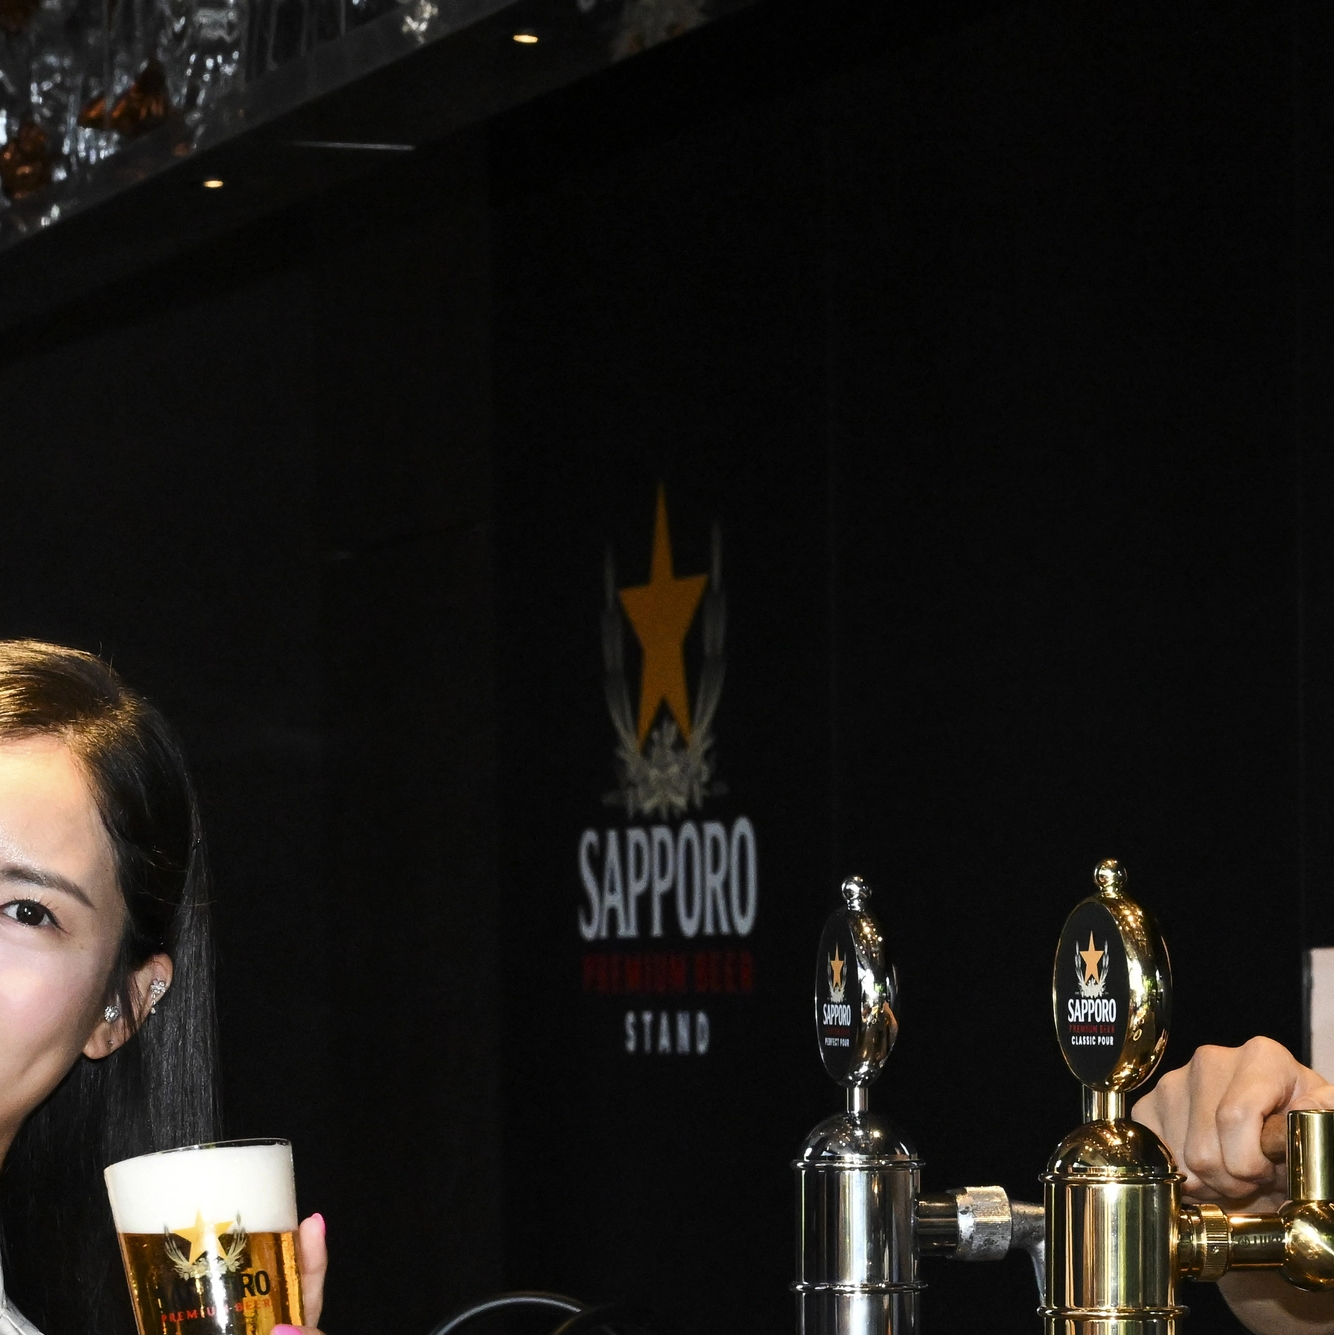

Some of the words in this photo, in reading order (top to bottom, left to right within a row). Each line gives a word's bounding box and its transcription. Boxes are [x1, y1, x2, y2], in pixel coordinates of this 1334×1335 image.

[578, 816, 758, 942] SAPPORO
[582, 953, 687, 994] PREMIUM
[695, 951, 755, 994] BEER
[822, 1003, 852, 1027] SAPPORO
[1067, 998, 1117, 1023] SAPPORO
[624, 1010, 710, 1055] STAND
[1071, 1035, 1096, 1046] CLASSIC
[1097, 1035, 1114, 1046] POUR
